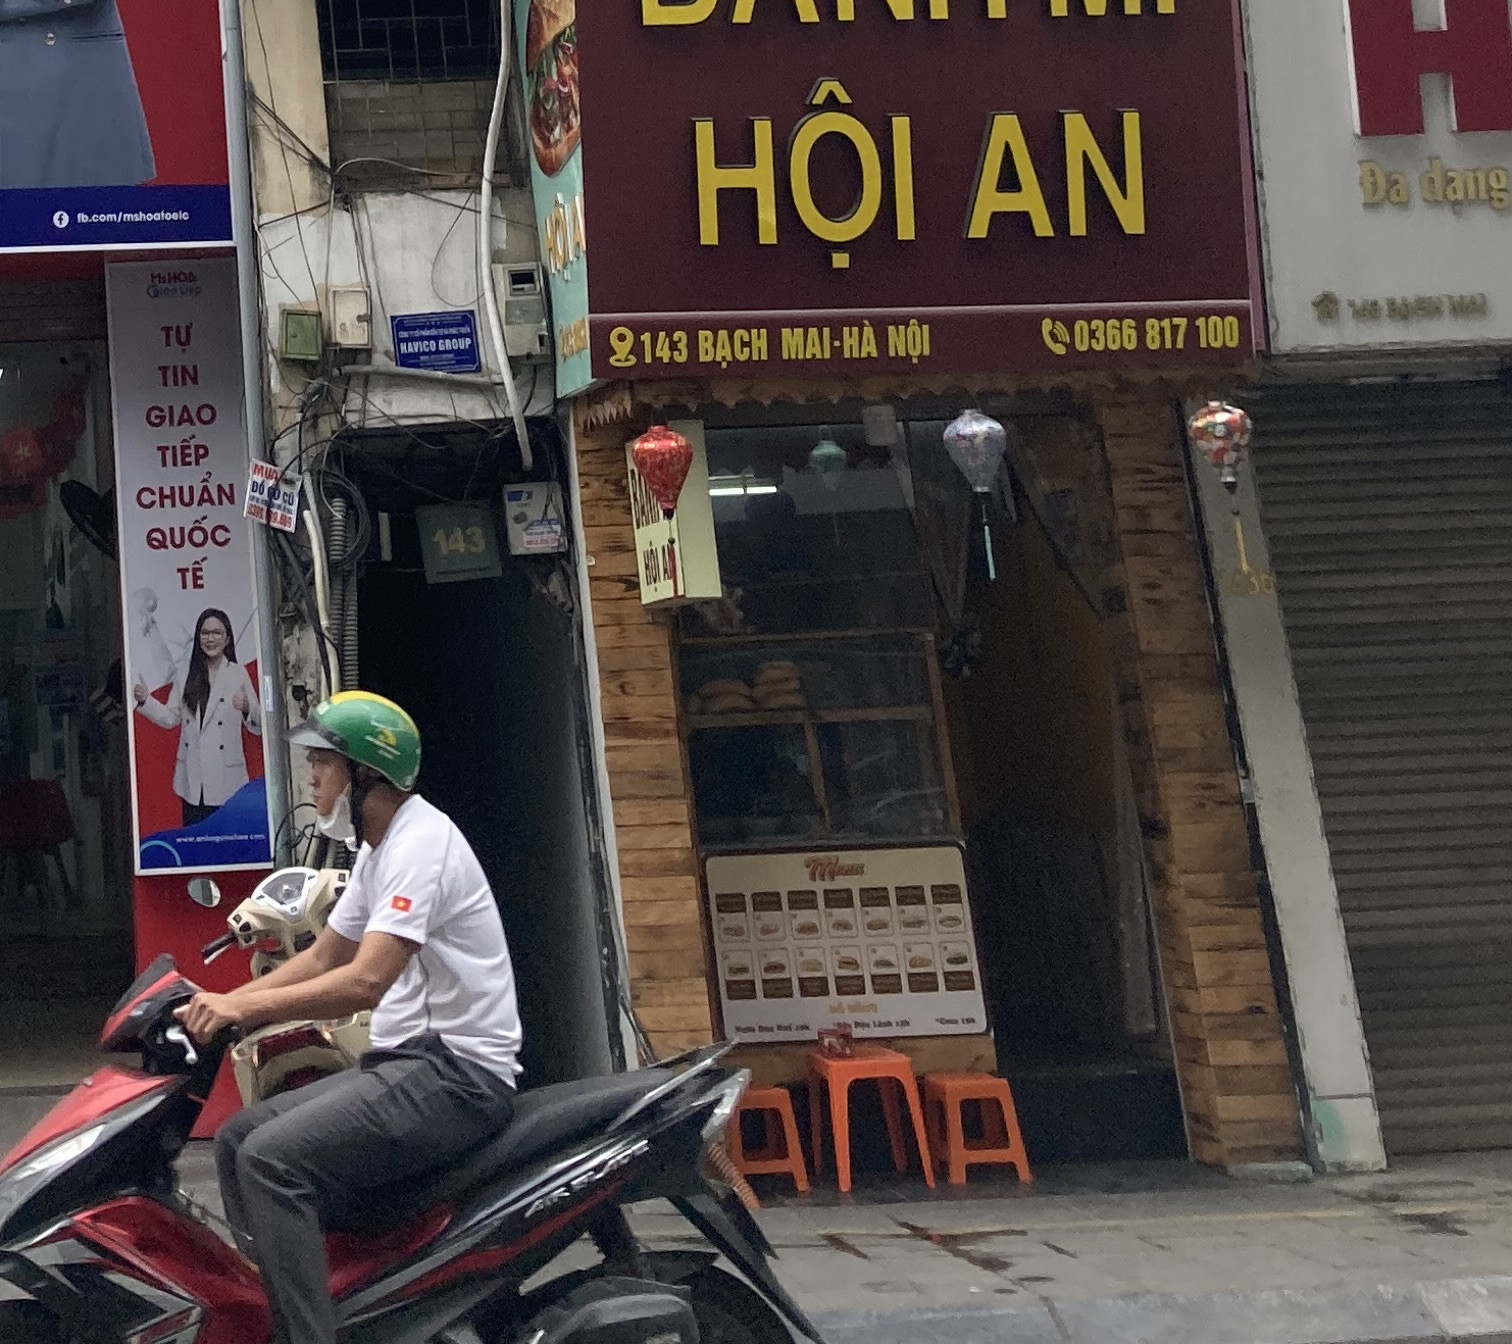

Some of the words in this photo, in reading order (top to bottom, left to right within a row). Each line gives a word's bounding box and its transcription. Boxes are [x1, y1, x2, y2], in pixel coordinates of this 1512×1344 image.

[693, 79, 916, 269] HỘI
[967, 112, 1146, 239] AN
[1357, 159, 1409, 205] Đa
[160, 322, 193, 353] TỰ
[640, 330, 688, 364] 143
[698, 327, 768, 369] BẠCH
[888, 319, 930, 367] NỘI
[1074, 318, 1137, 351] 0366
[1146, 317, 1187, 350] 817
[1195, 316, 1239, 349] 100
[158, 364, 199, 387] TIN
[145, 403, 217, 428] GIAO
[156, 434, 209, 468] TIẾP
[253, 463, 278, 481] MUA
[136, 471, 235, 510] CHUẨN
[146, 515, 231, 550] QUỐC
[433, 526, 486, 555] 143
[177, 556, 208, 590] TẾ
